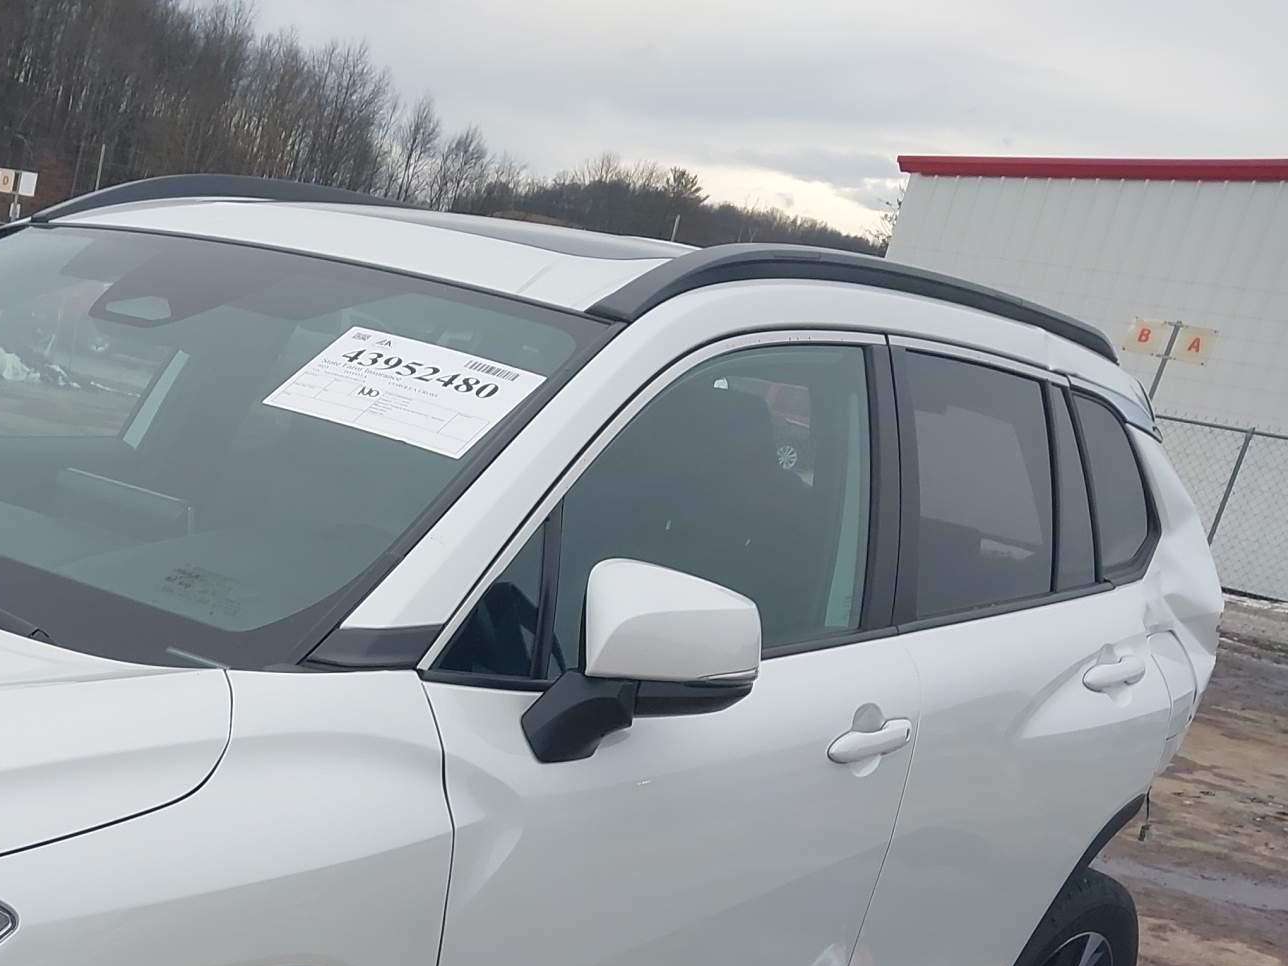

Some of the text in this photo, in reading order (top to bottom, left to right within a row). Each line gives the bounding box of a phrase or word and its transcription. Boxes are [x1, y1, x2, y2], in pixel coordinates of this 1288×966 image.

[1138, 328, 1151, 343] B
[1187, 337, 1201, 352] A
[342, 349, 499, 398] 43952480
